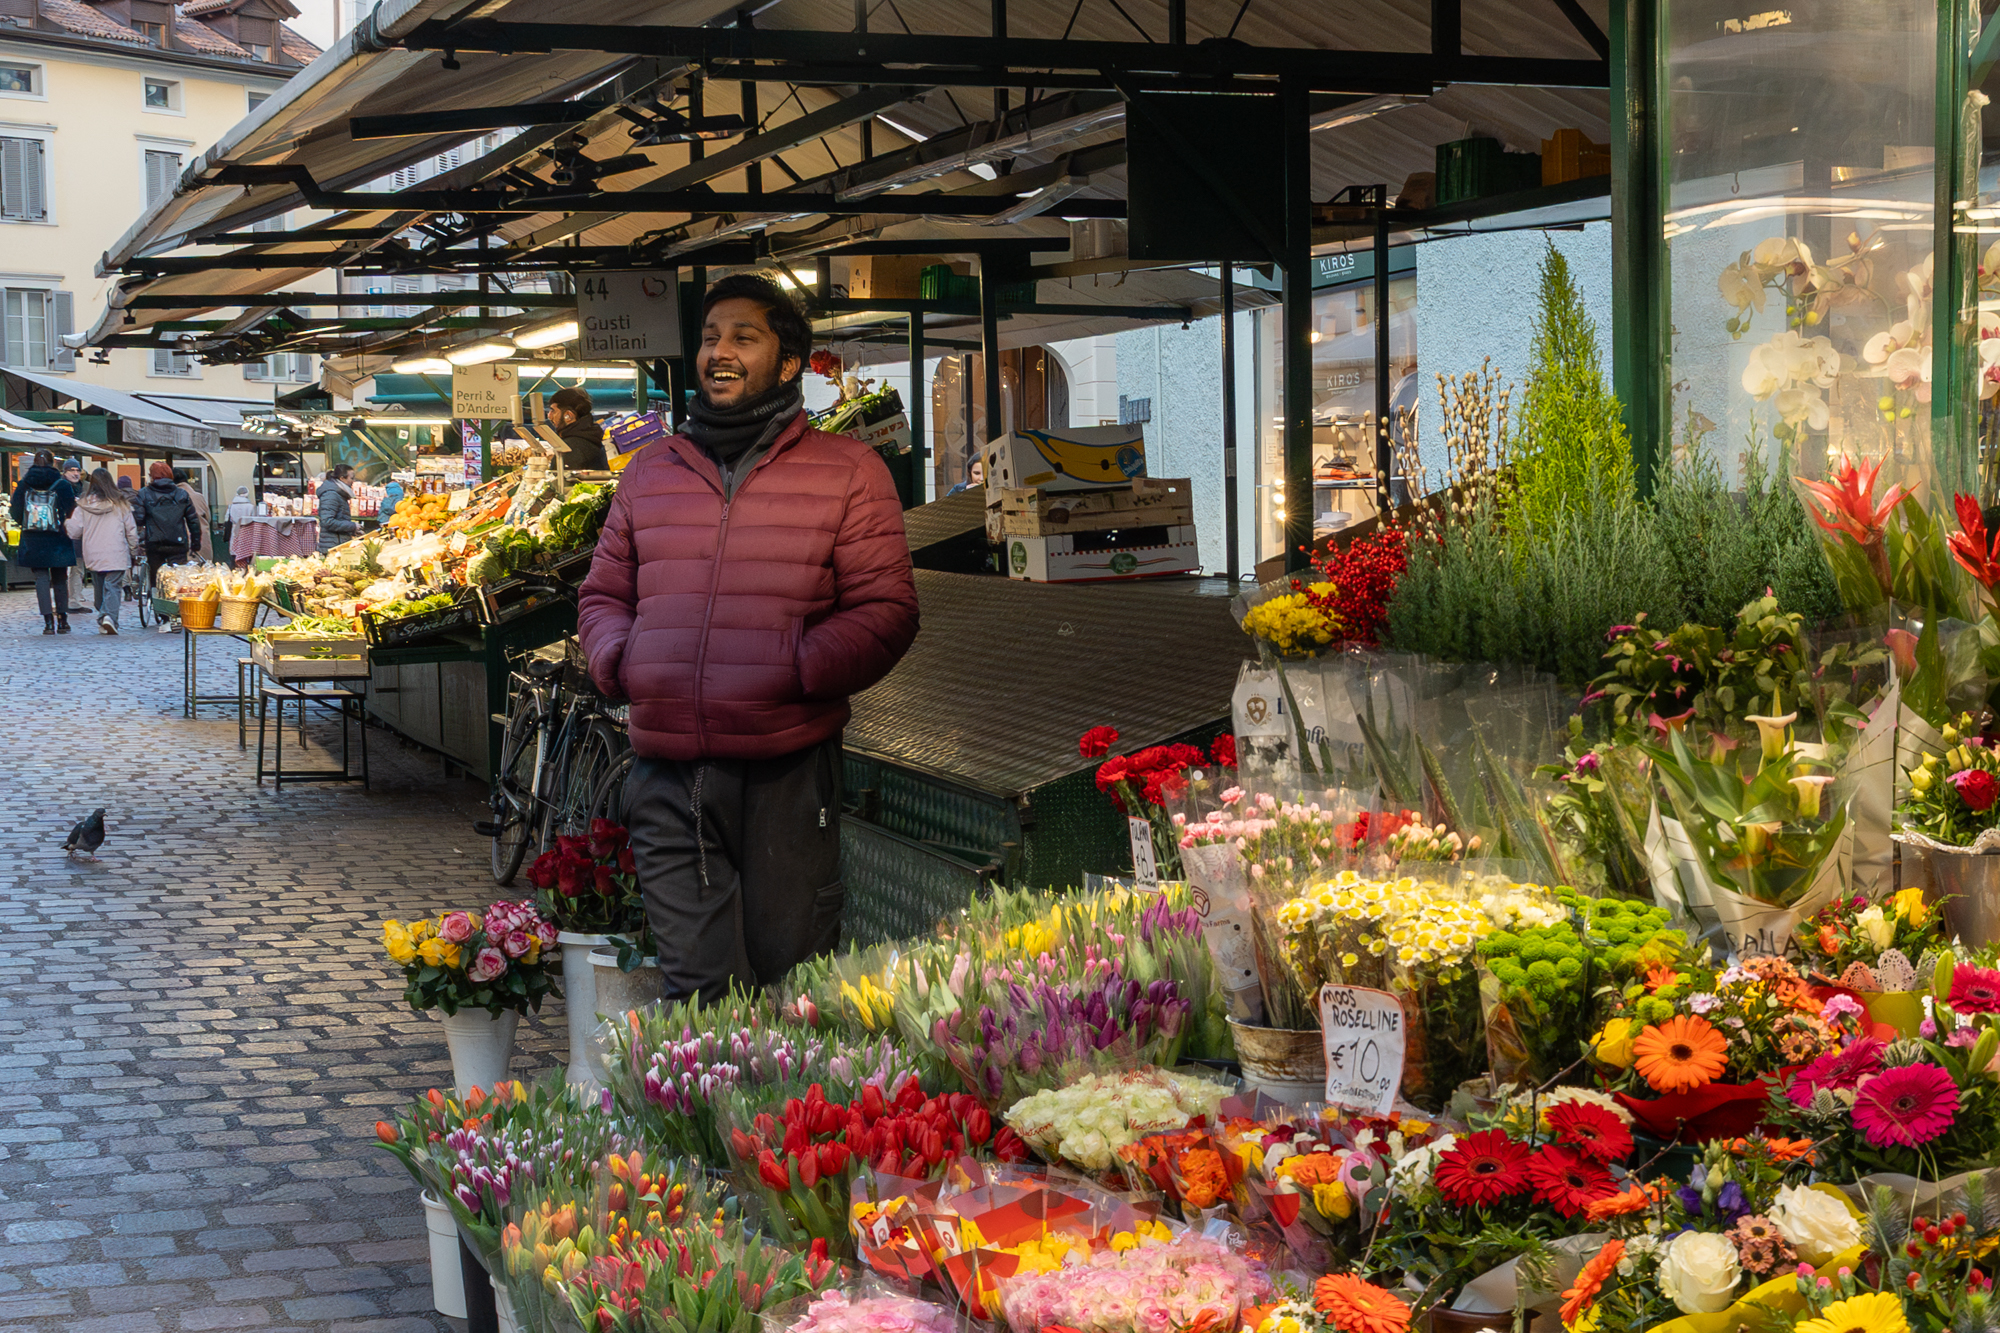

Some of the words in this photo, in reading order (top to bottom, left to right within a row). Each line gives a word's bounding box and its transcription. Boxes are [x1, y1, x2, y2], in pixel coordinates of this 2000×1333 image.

[1319, 253, 1355, 272] KIRO'S
[584, 277, 609, 301] 44
[585, 315, 630, 331] Gusti
[586, 333, 647, 351] Italiani
[456, 367, 468, 376] 42
[1326, 372, 1361, 388] KIRO'S
[456, 390, 482, 401] Perri
[486, 390, 495, 401] &
[456, 403, 508, 414] D'Andrea
[1332, 1004, 1399, 1032] ROSELLINE
